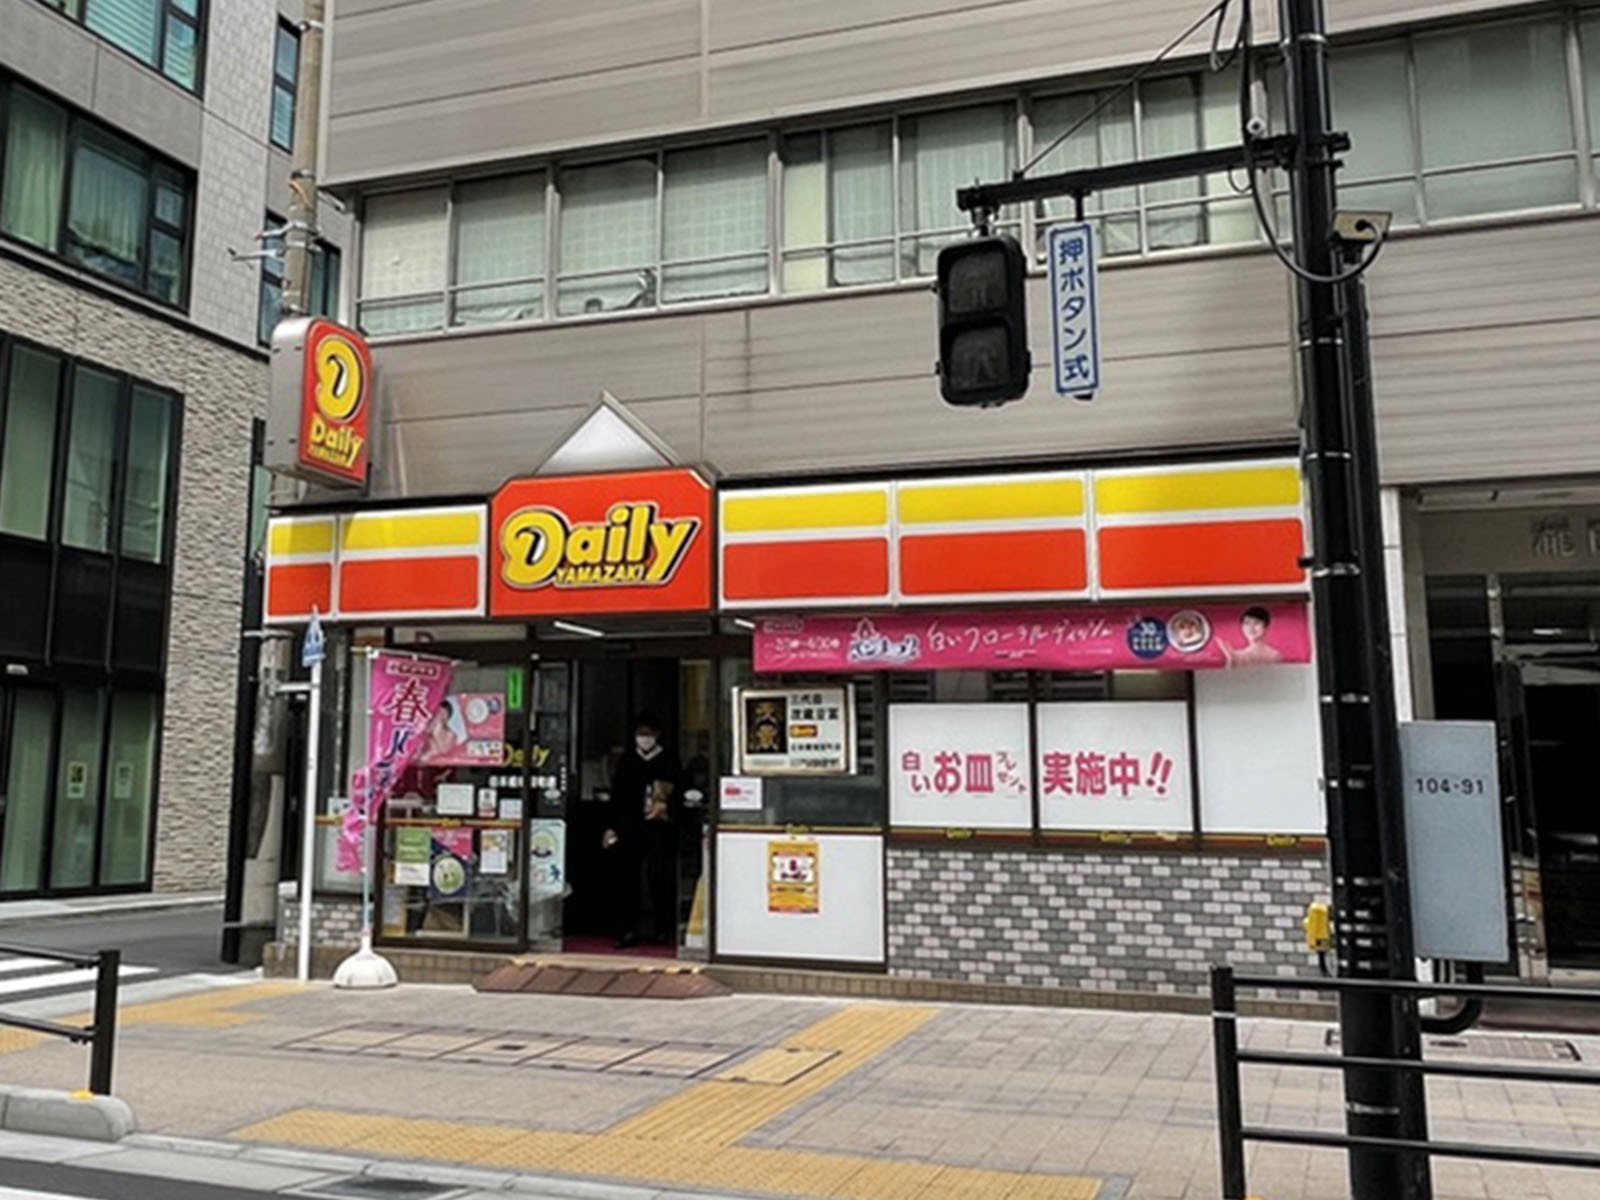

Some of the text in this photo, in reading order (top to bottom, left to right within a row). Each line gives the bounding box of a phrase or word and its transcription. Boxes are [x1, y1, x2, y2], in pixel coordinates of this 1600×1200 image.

[1059, 238, 1090, 382] 押ボタン式
[309, 412, 365, 469] Daily
[502, 502, 699, 588] Daily
[554, 564, 646, 585] YAMAZAKI
